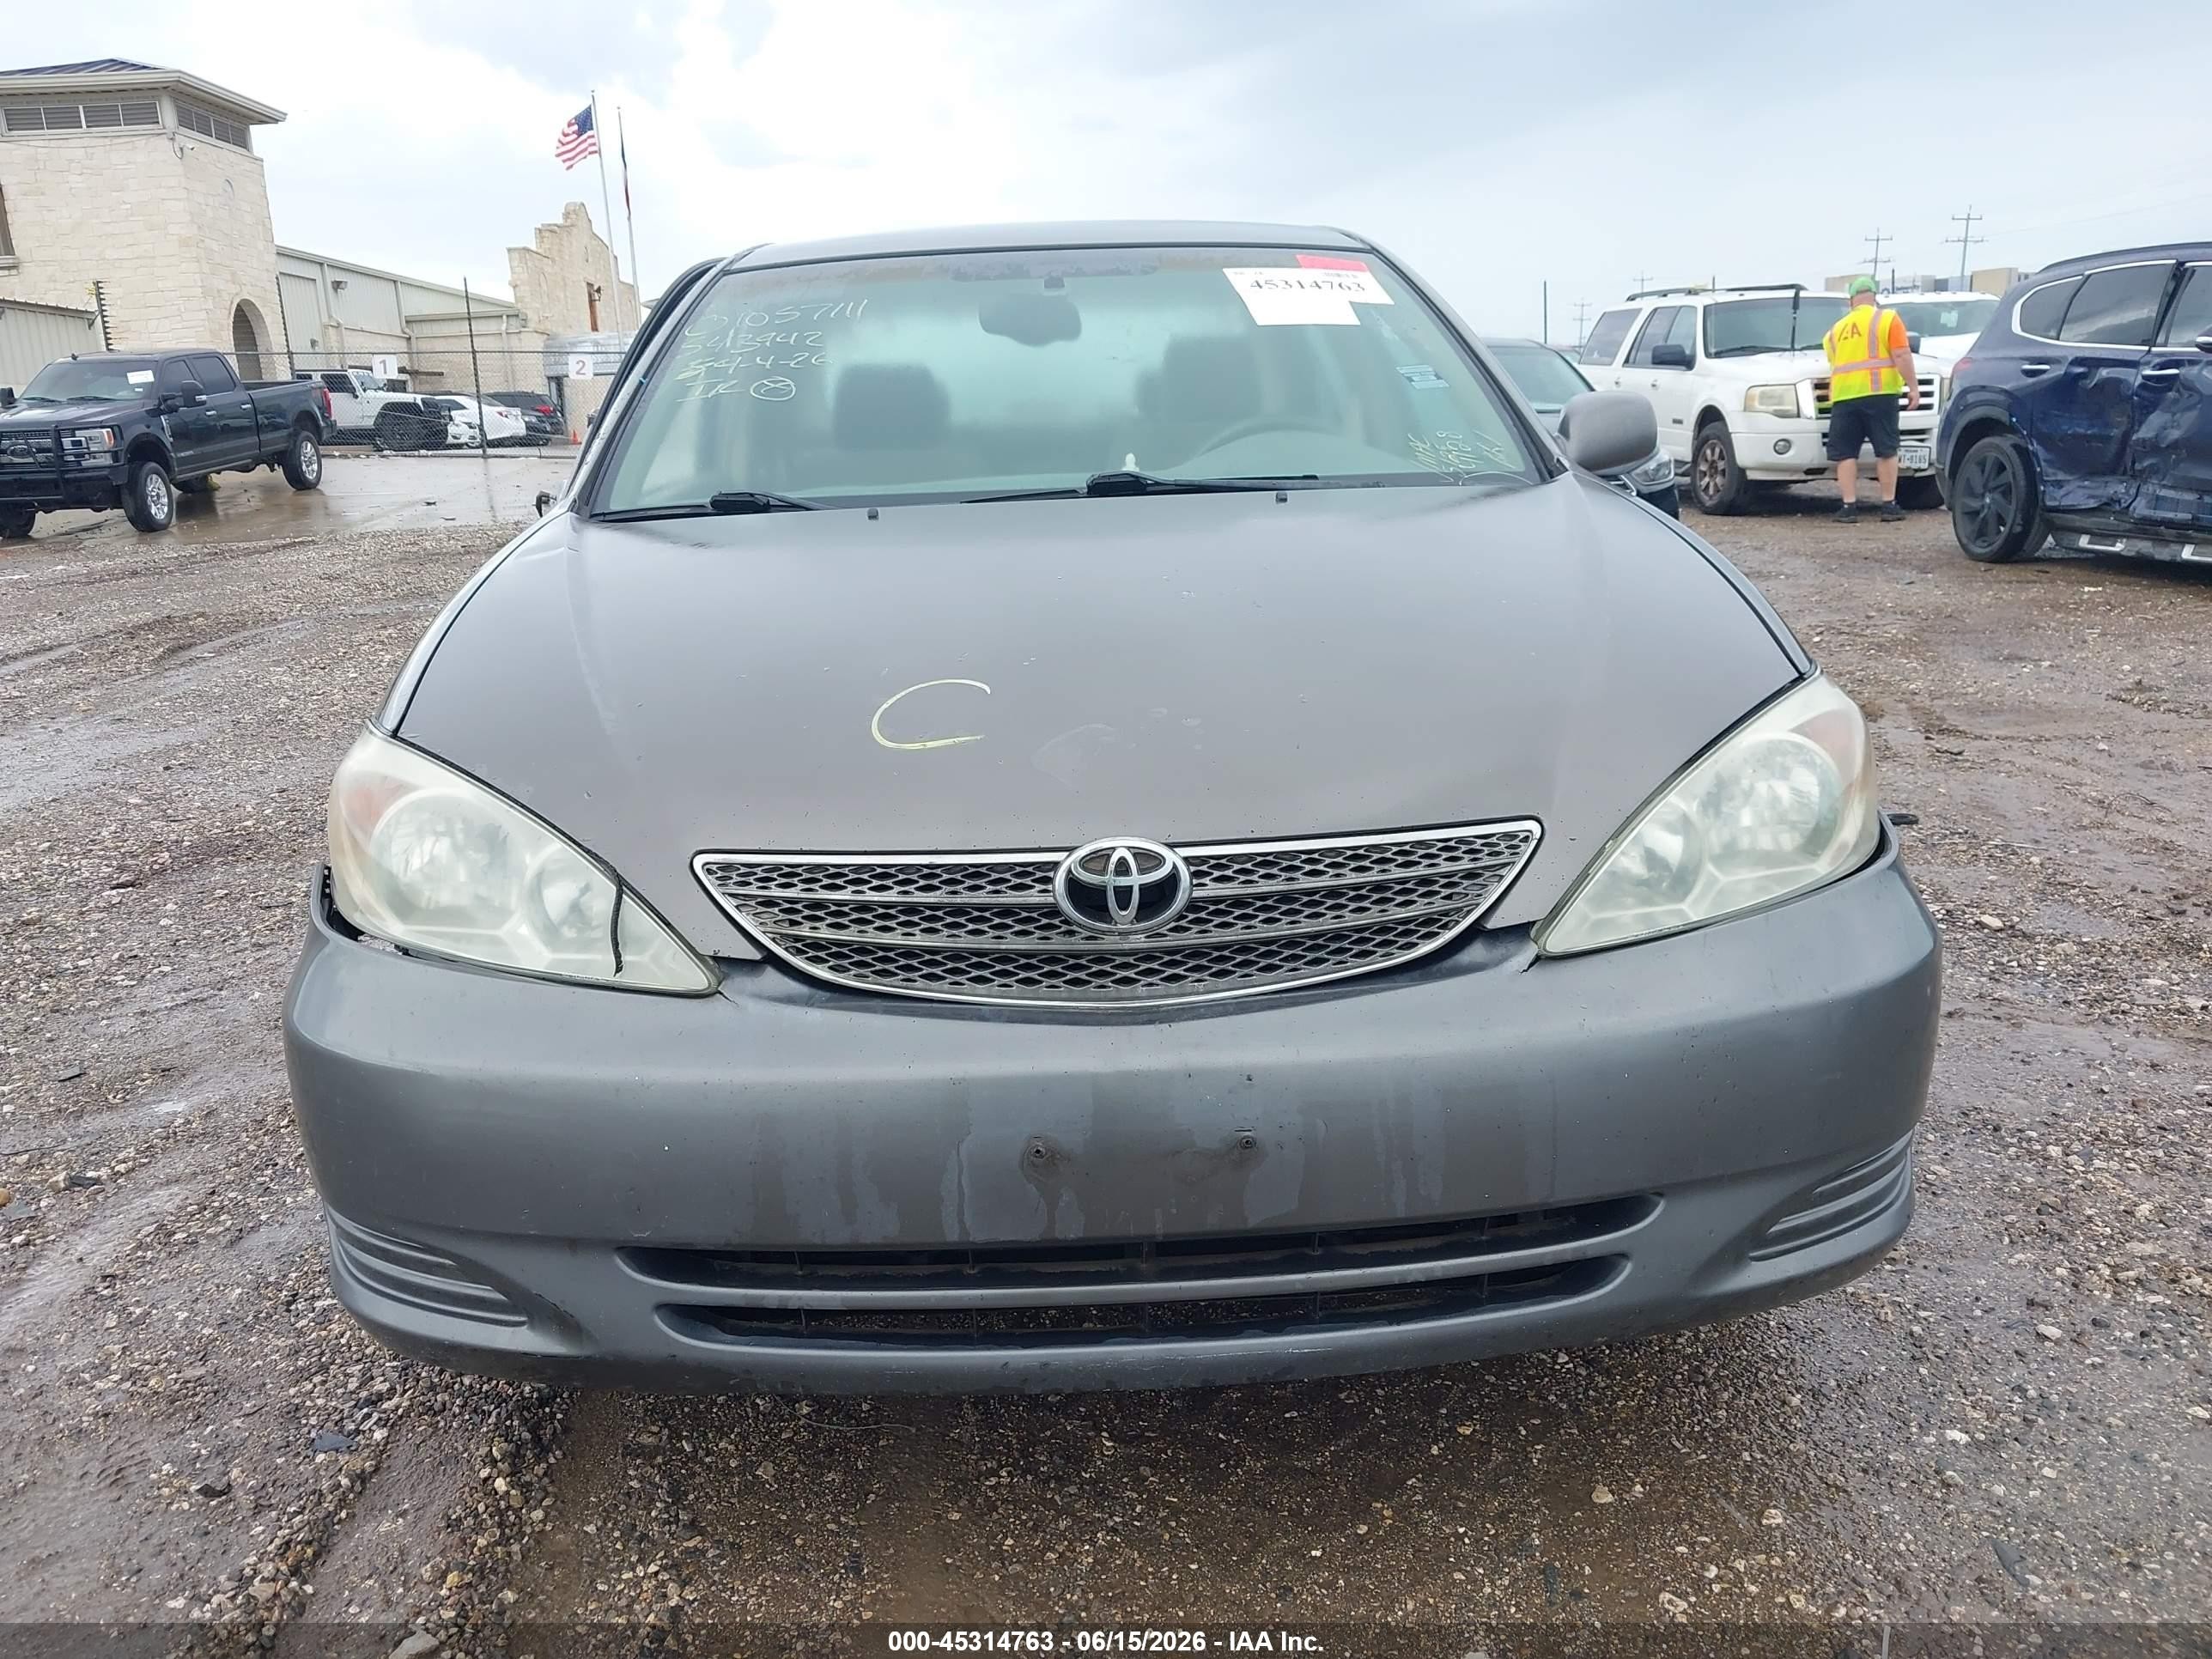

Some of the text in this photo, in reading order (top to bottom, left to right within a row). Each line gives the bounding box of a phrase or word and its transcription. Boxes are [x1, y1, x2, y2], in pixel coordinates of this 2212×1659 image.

[1249, 278, 1366, 293] 45314763
[379, 359, 387, 374] 1
[575, 359, 586, 375] 2
[871, 678, 991, 750] C
